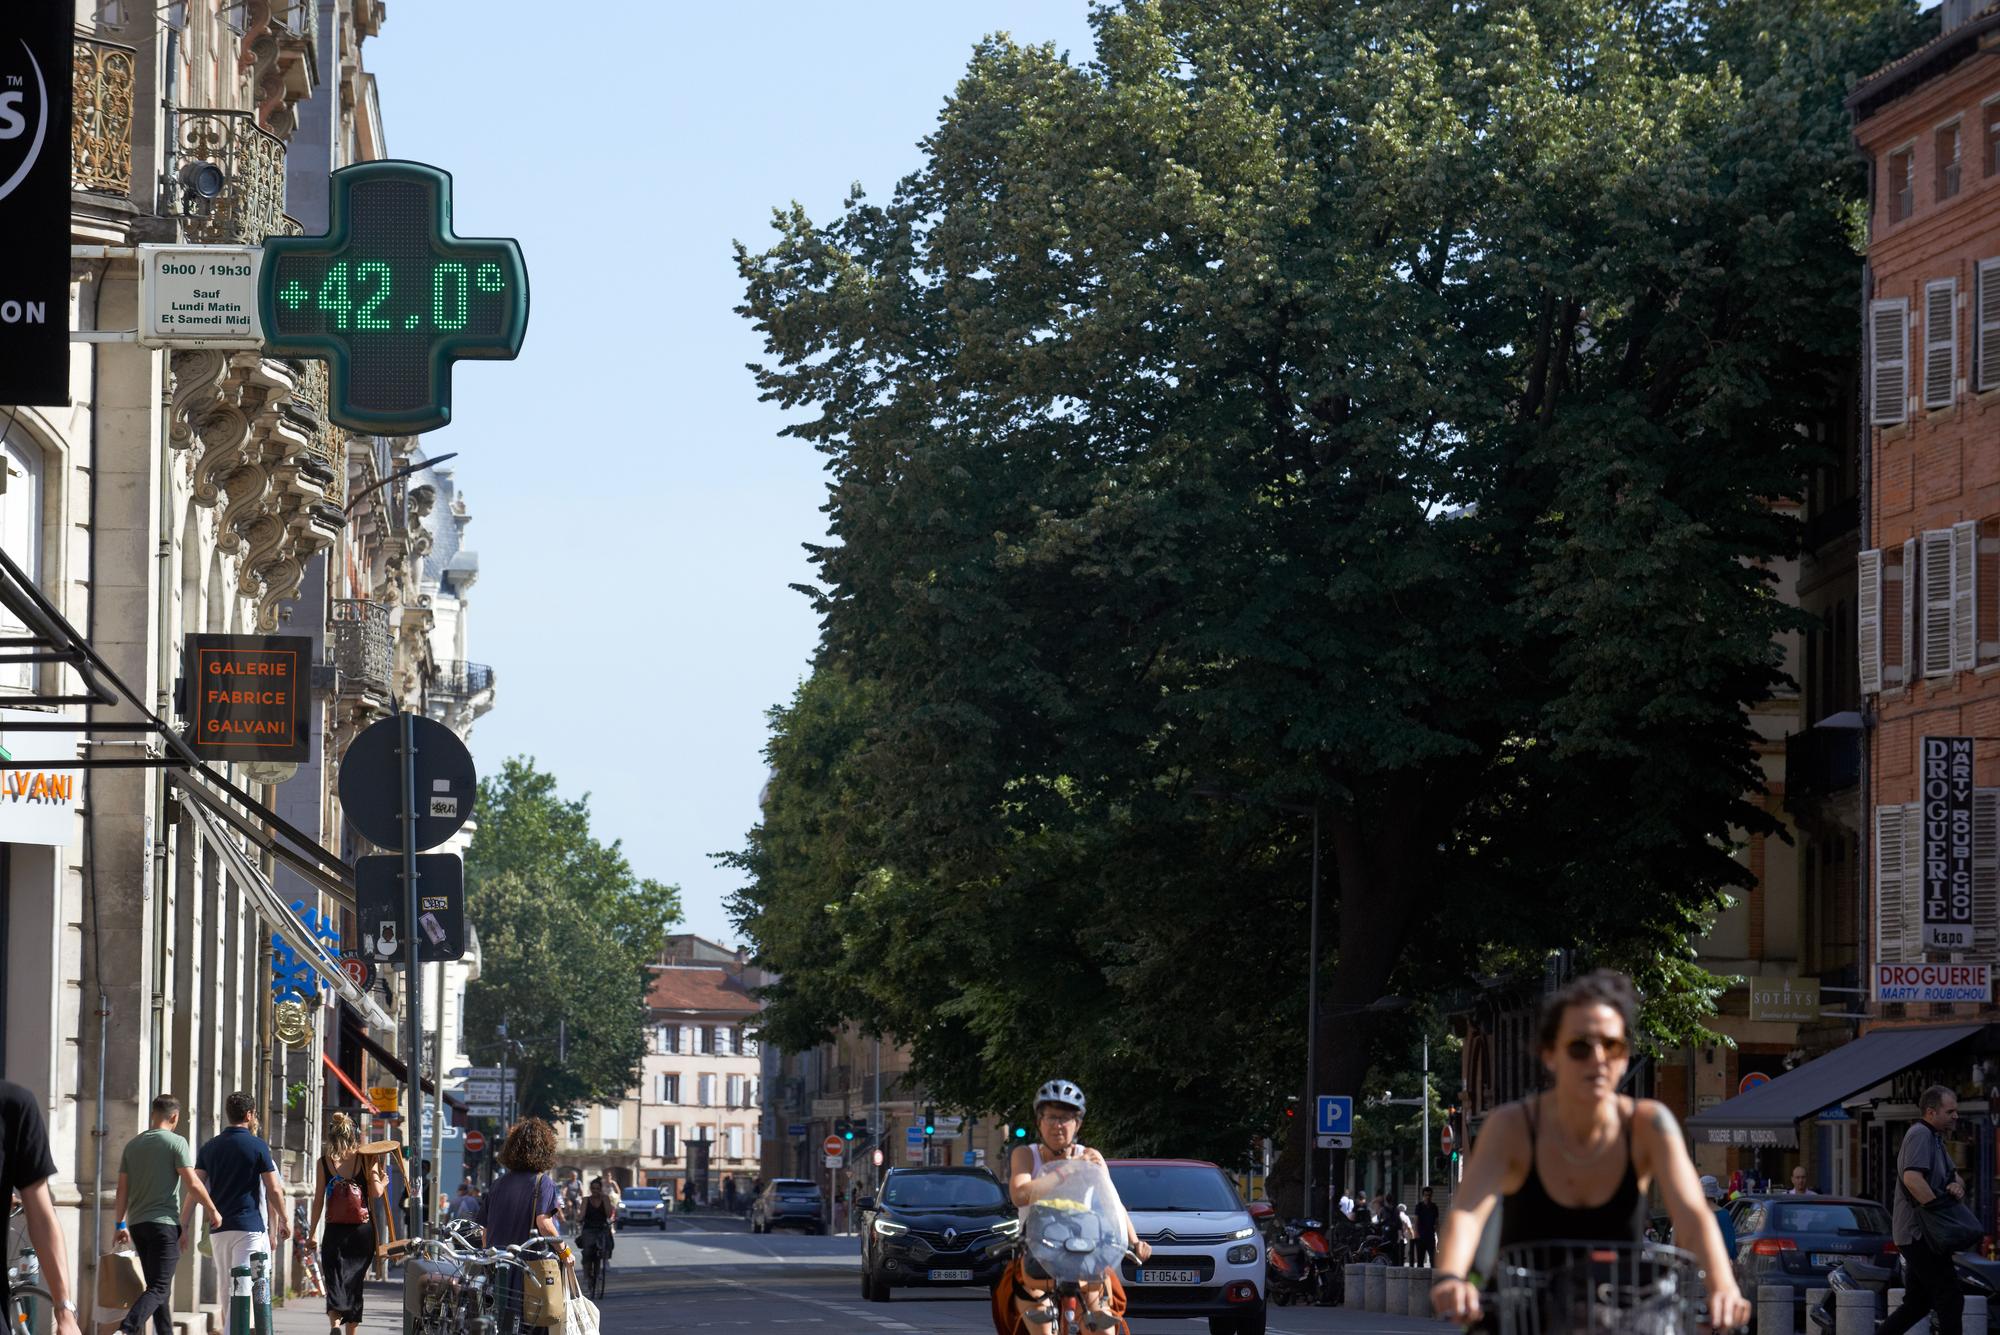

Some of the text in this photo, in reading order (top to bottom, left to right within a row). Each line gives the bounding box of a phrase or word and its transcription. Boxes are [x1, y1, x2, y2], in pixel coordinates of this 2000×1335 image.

[161, 264, 196, 275] 9h00
[209, 265, 251, 276] 19h30
[193, 289, 221, 299] Sauf
[171, 302, 241, 312] Lundi Matin
[161, 315, 251, 325] Et Samedi Midi
[209, 661, 287, 676] GALERIE
[208, 690, 286, 705] FABRICE
[207, 719, 285, 734] GALVANI
[1926, 740, 1949, 920] DROGUERIE
[1952, 740, 1970, 920] MARTY ROUBICHOU
[1933, 928, 1964, 946] kapo
[1880, 966, 1986, 986] DROGUERIE
[1753, 991, 1813, 1006] SOTHYS
[1881, 987, 1985, 1000] MARTY ROUBICHOU
[1327, 1103, 1343, 1127] P
